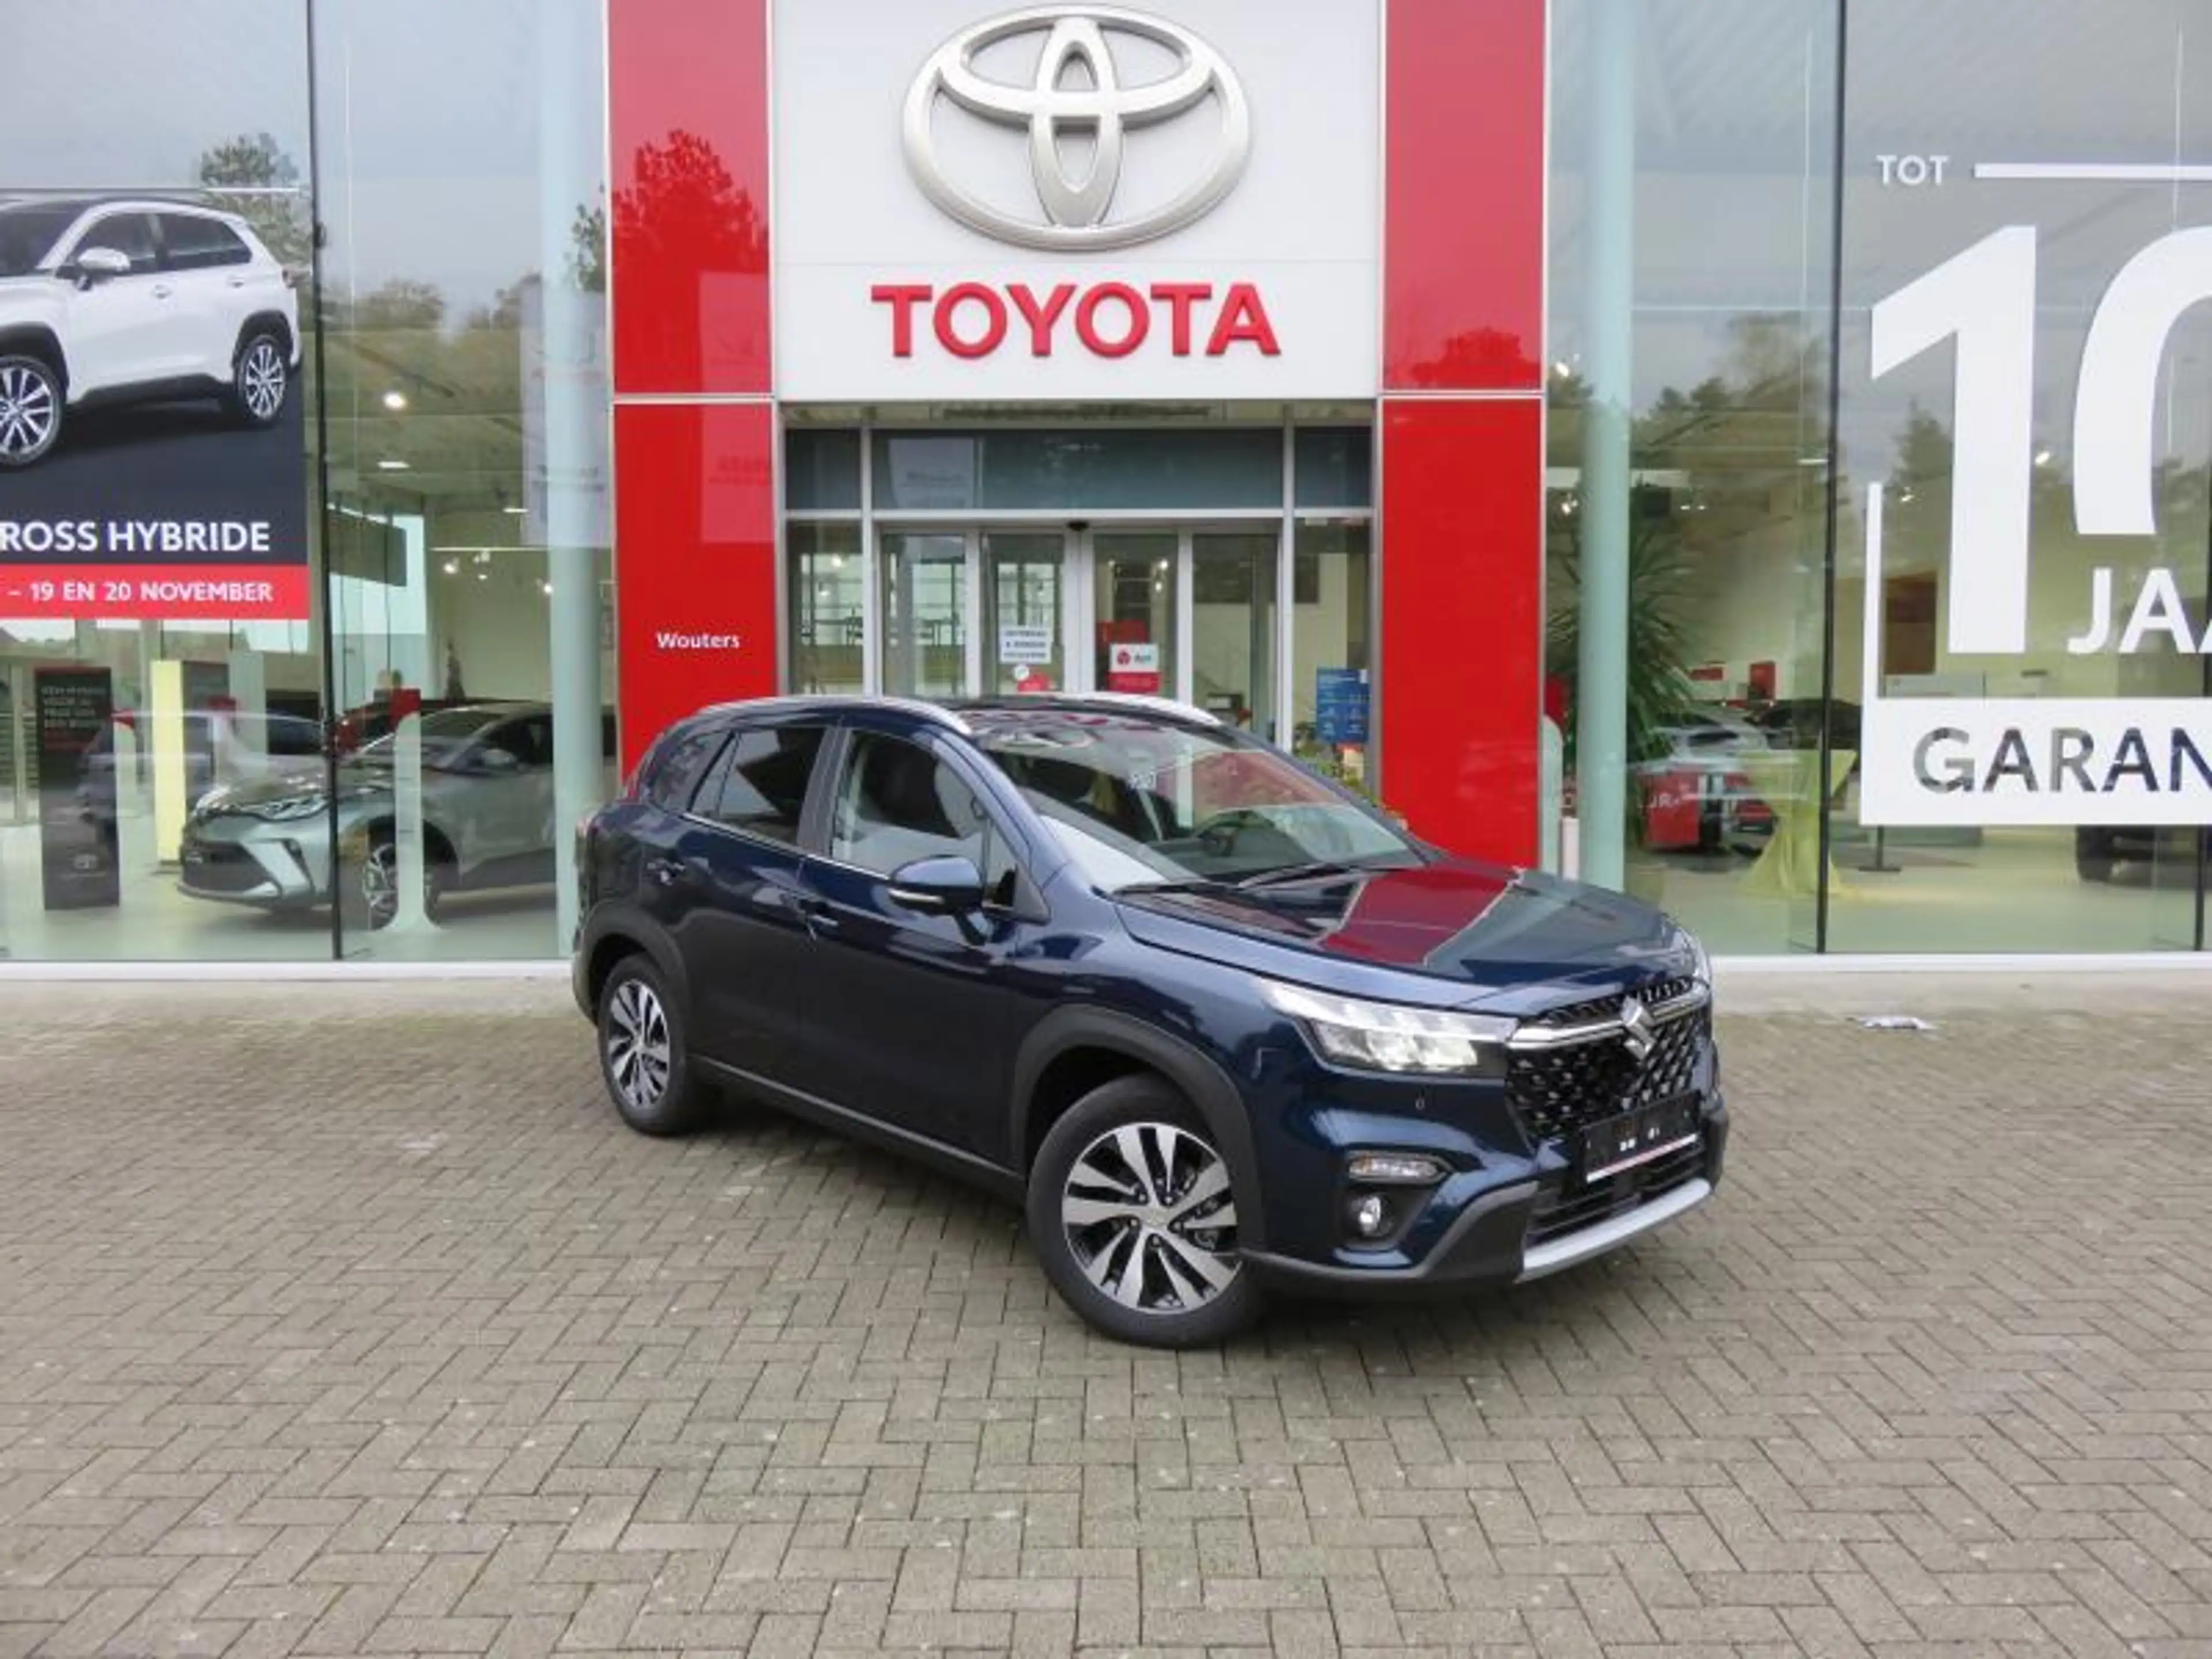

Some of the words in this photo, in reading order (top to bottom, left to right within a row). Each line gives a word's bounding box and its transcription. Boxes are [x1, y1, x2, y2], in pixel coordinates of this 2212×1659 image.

[1876, 154, 1949, 185] TOT
[871, 282, 1282, 358] TOYOTA
[0, 521, 98, 551] ROSS
[108, 521, 271, 552] HYBRIDE
[30, 582, 55, 601] 19
[63, 582, 96, 601] EN
[103, 582, 132, 601] 20
[140, 582, 274, 602] NOVEMBER
[2067, 568, 2212, 654] JA
[656, 632, 740, 649] Wouters
